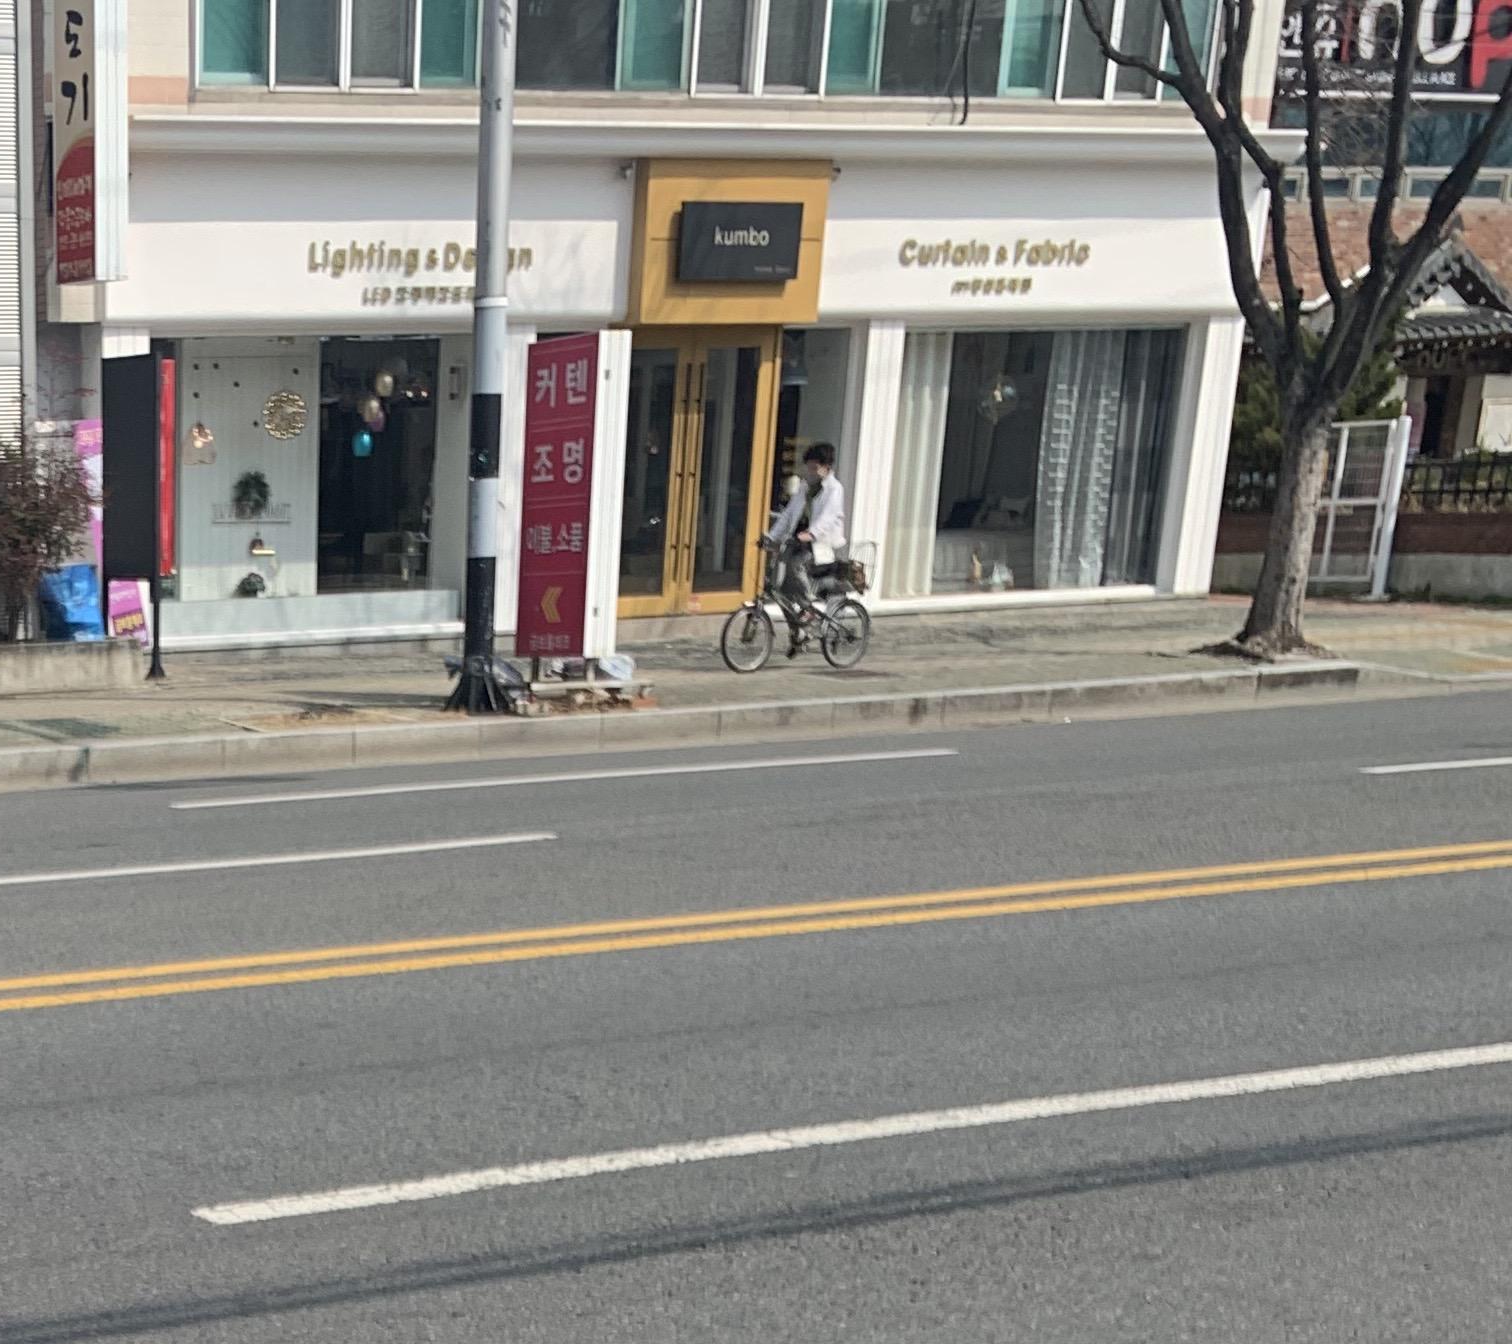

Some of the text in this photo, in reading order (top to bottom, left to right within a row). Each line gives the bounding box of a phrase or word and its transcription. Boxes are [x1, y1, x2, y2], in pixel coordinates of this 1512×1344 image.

[714, 225, 770, 246] kumbo
[308, 240, 420, 278] Lighting
[442, 241, 532, 275] Den
[898, 238, 990, 267] Curtain
[1012, 239, 1091, 267] Fabric
[531, 437, 585, 484] 조명
